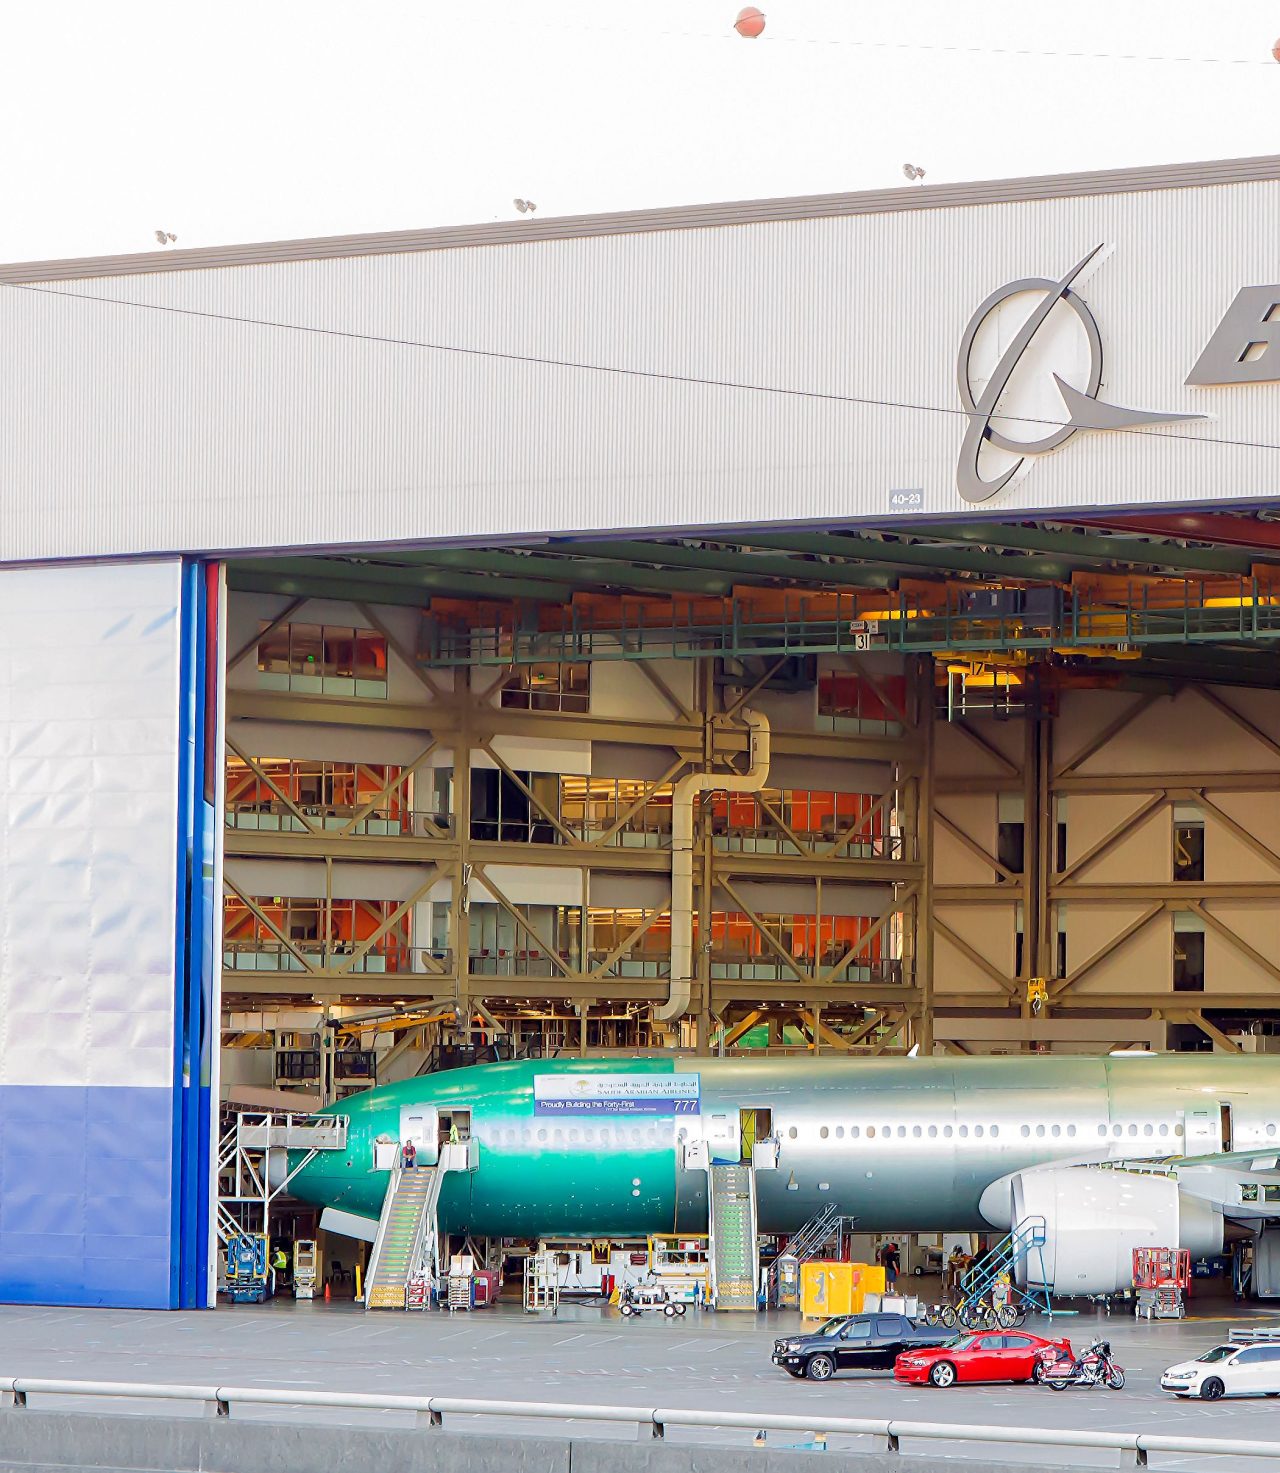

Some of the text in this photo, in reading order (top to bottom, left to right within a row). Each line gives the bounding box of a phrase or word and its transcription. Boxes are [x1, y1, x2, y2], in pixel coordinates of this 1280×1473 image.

[891, 493, 921, 505] 40-23
[857, 634, 868, 649] 31
[540, 1101, 565, 1109] Proudly
[566, 1101, 591, 1109] Building
[673, 1100, 698, 1111] 777
